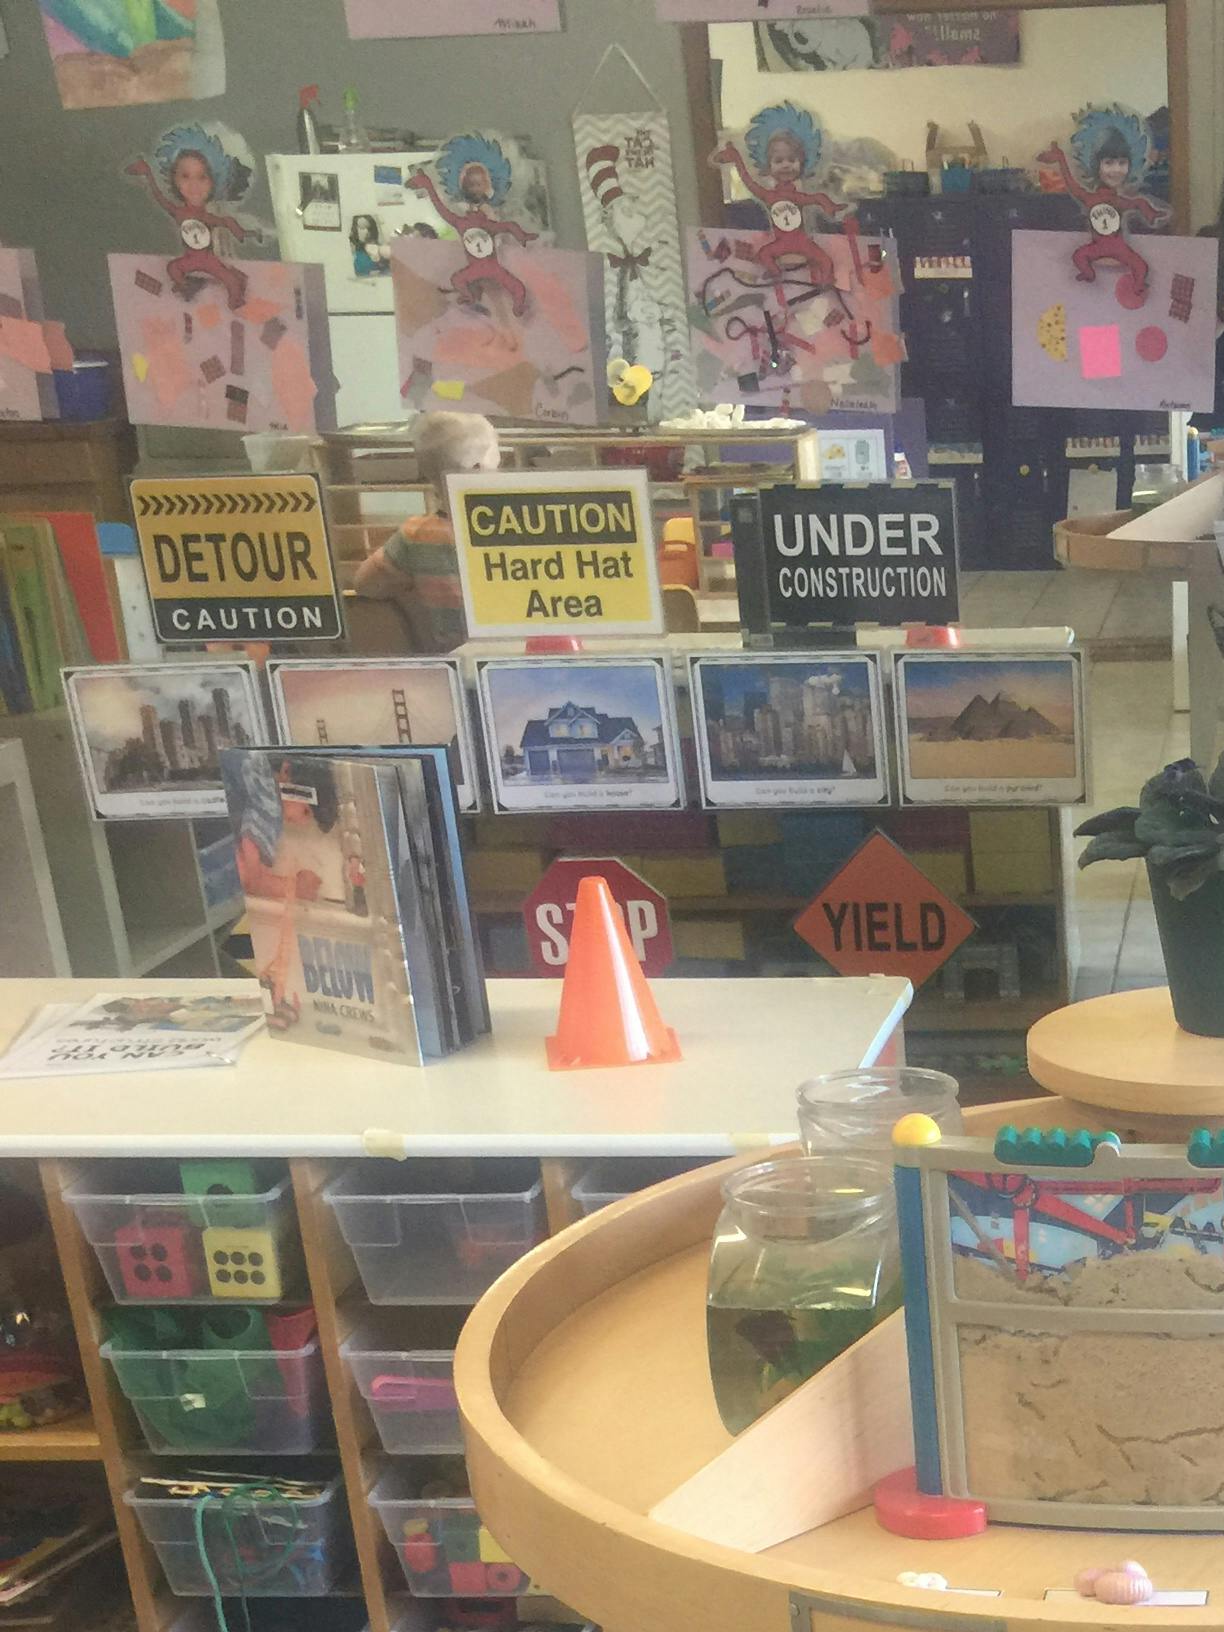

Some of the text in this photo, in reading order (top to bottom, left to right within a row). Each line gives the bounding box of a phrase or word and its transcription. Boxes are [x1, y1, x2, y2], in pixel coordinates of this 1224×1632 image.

[470, 502, 633, 537] CAUTION
[773, 513, 944, 557] UNDER
[153, 531, 318, 583] DETOUR
[483, 550, 634, 582] Hard Hat
[779, 566, 947, 598] CONSTRUCTION
[171, 606, 323, 631] CAUTION
[525, 588, 603, 618] Area
[536, 900, 658, 966] SP
[822, 902, 947, 952] YIELD
[340, 1004, 375, 1022] CREWS
